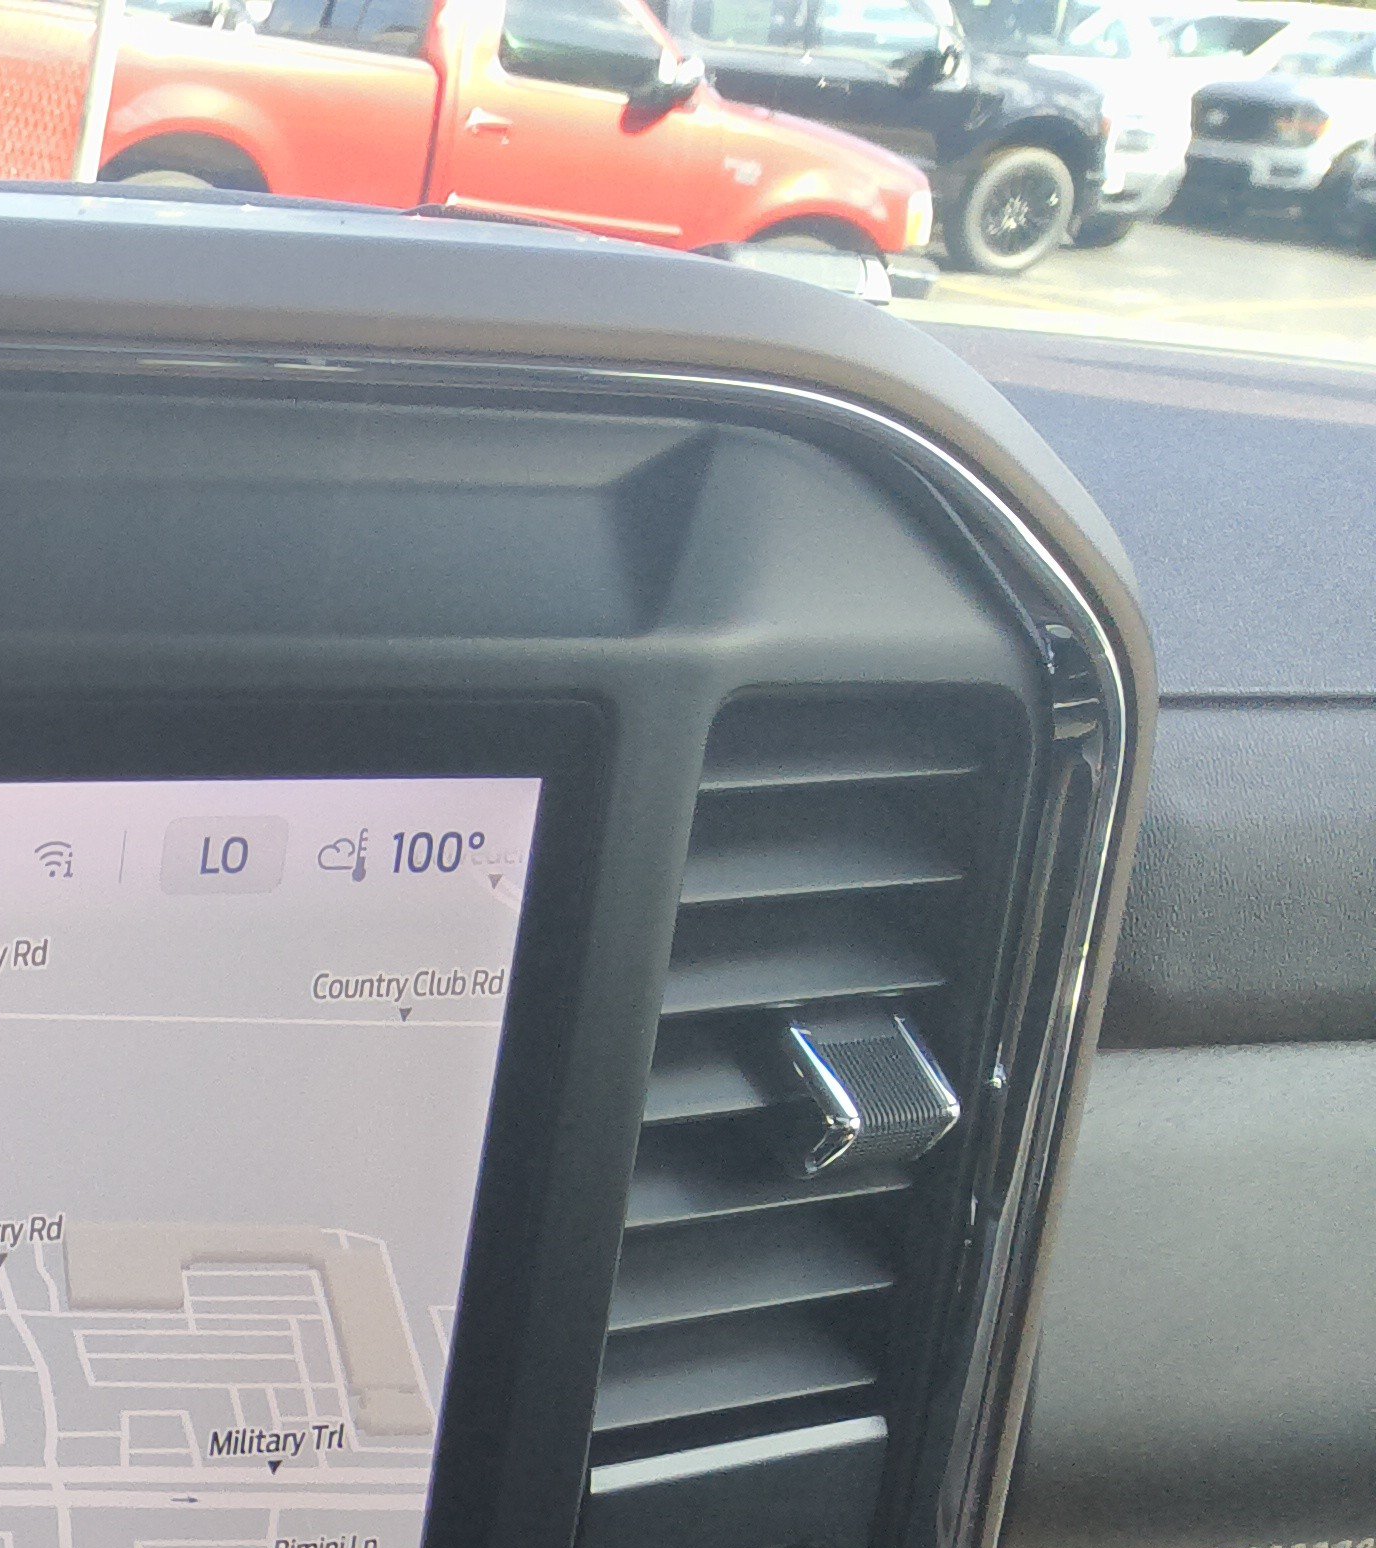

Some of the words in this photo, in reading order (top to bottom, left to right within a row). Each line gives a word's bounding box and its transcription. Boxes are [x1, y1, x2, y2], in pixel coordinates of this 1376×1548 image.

[199, 836, 249, 875] LO
[393, 831, 486, 873] 100°
[14, 939, 49, 967] Rd
[312, 972, 409, 1004] Country
[413, 970, 464, 997] Club
[470, 969, 504, 996] Rd
[28, 1216, 64, 1243] Rd
[209, 1429, 304, 1458] Military
[311, 1425, 344, 1449] Trl
